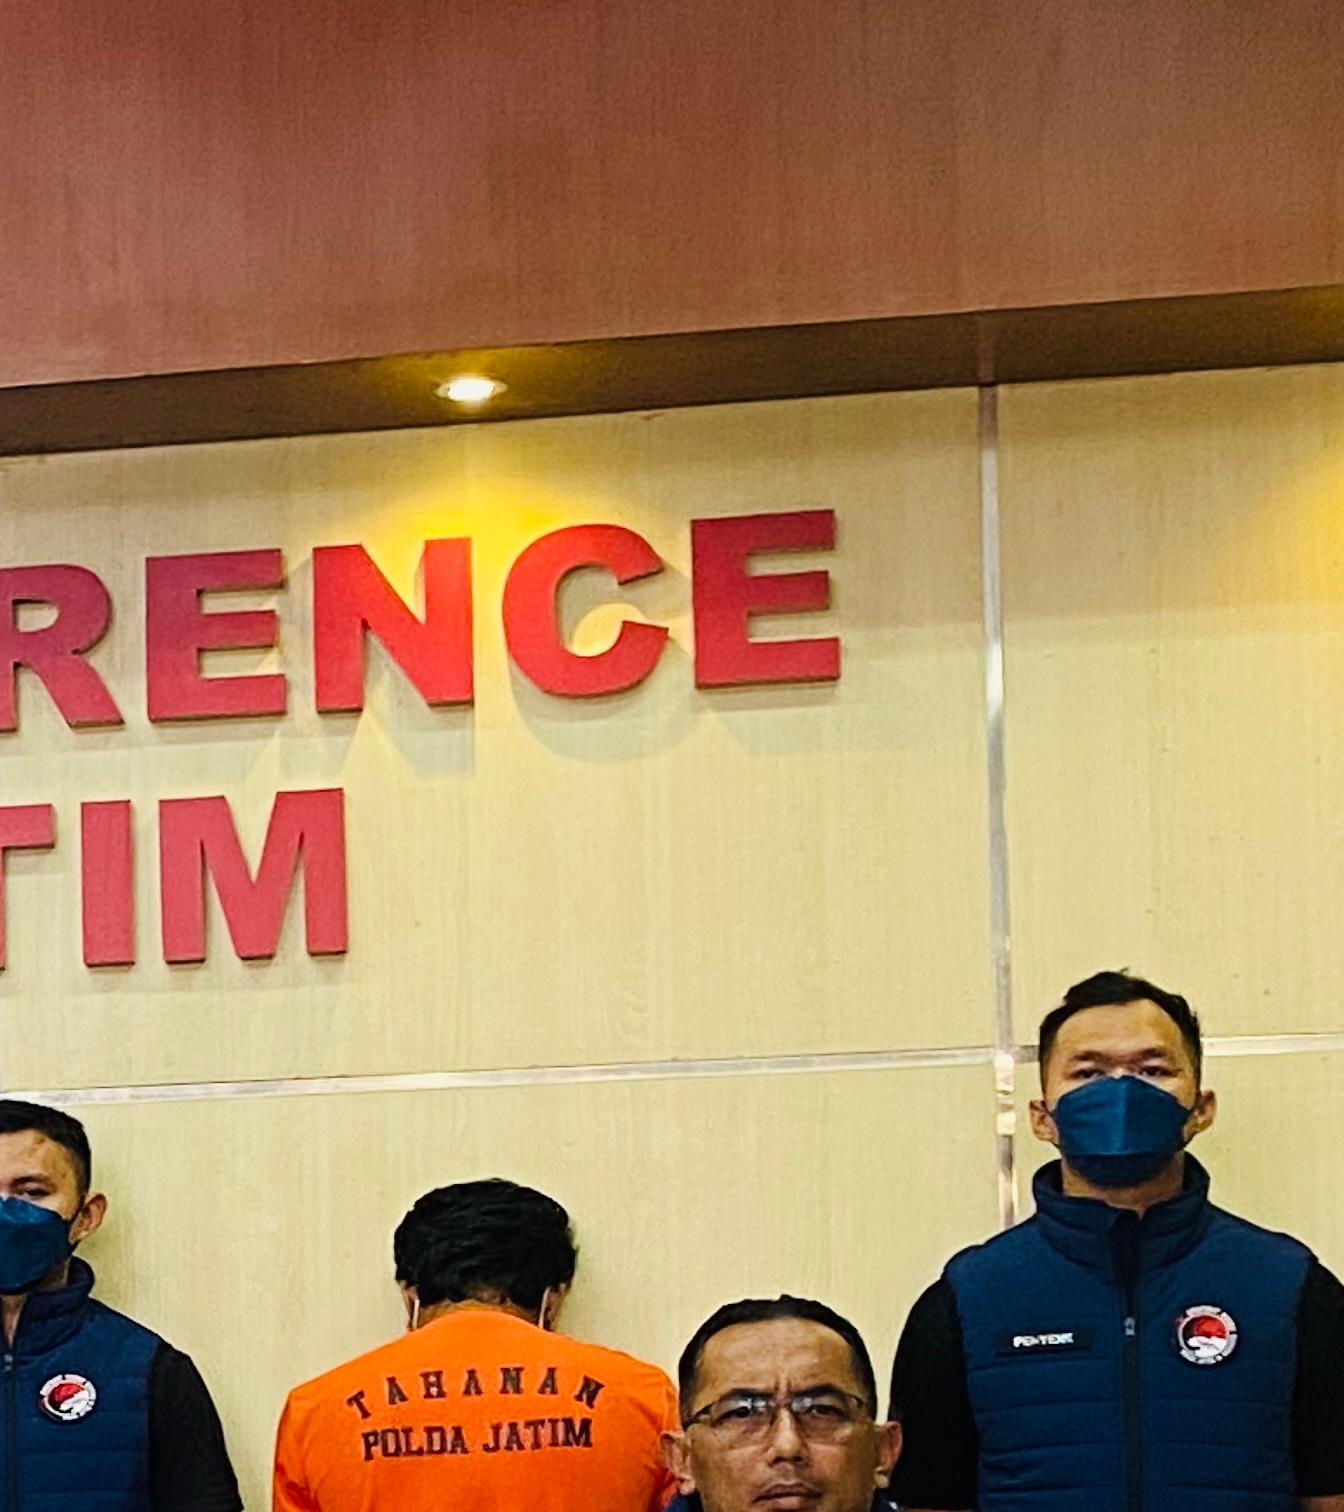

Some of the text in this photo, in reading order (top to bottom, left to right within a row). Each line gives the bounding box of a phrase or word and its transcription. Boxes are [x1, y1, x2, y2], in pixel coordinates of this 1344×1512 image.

[346, 1367, 605, 1421] TAHANAN
[362, 1417, 592, 1461] POLDA JATIM
